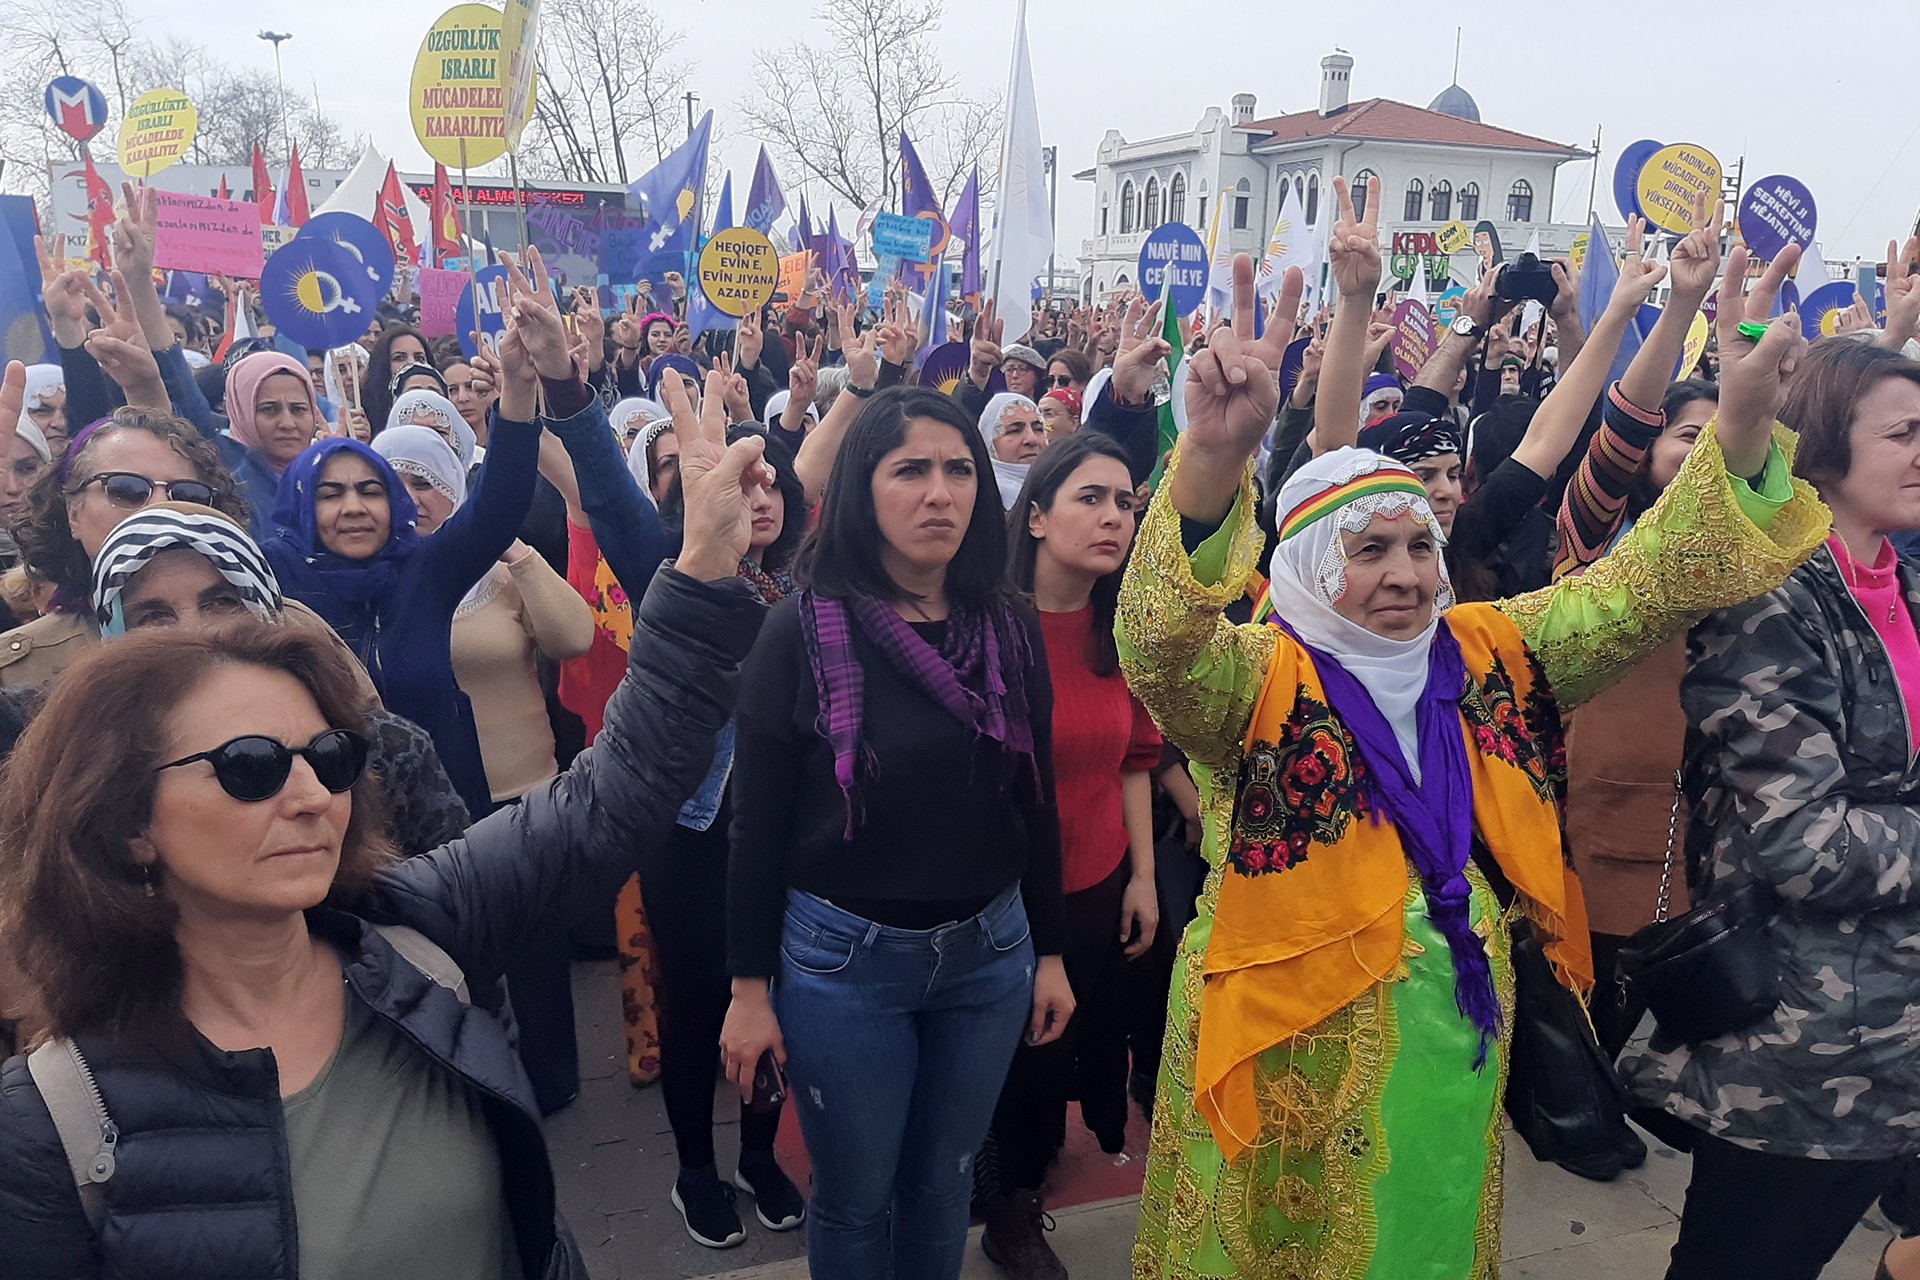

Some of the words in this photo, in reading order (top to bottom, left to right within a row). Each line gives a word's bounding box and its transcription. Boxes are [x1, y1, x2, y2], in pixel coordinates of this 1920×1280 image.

[441, 58, 496, 80] ISRARLI
[125, 129, 185, 150] MÜCADELEDE
[1677, 150, 1717, 180] KADINLAR
[1749, 201, 1790, 240] HÊJATIR
[1753, 186, 1812, 242] SERKEFTINÊ
[1796, 207, 1808, 220] JI
[715, 241, 769, 257] HEQÎQET
[1147, 240, 1179, 261] NAVÊ
[1181, 243, 1202, 262] MIN
[720, 255, 750, 269] EVÎN
[703, 270, 733, 284] EVÎN
[736, 274, 775, 286] JIYANA
[1189, 269, 1203, 287] YE
[717, 287, 750, 300] AZAD
[752, 289, 760, 300] E
